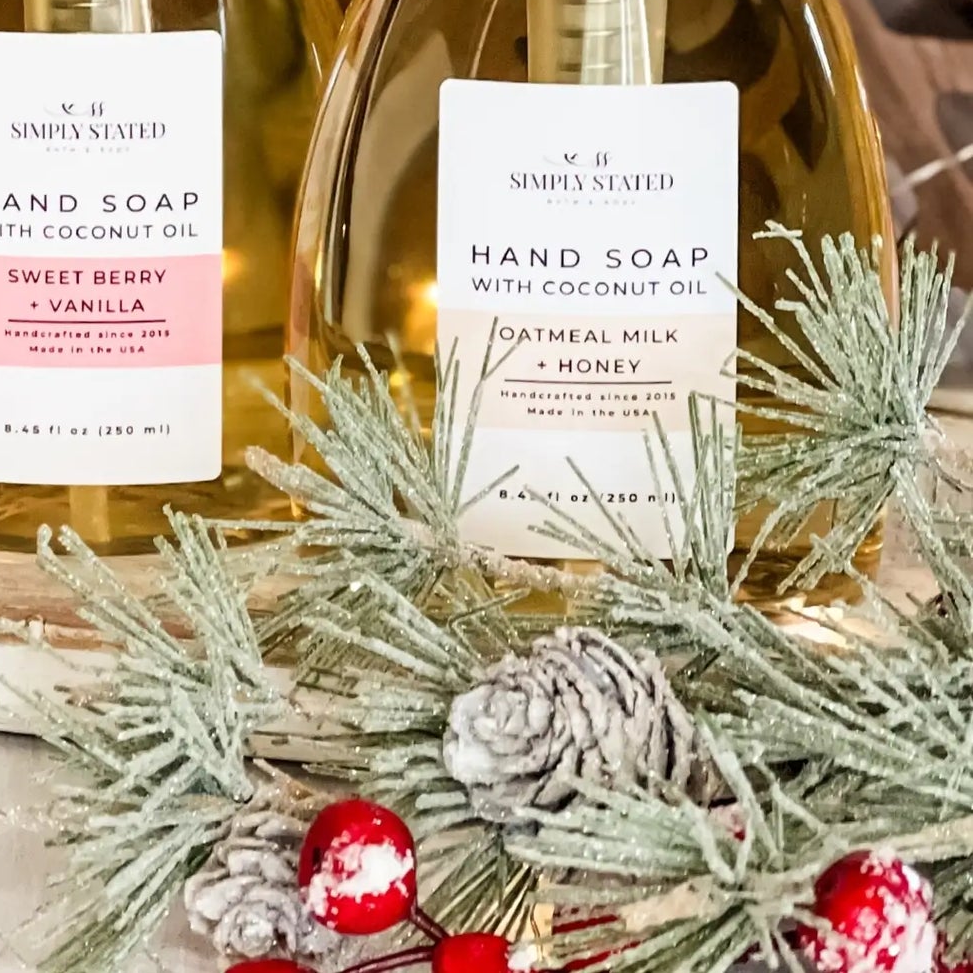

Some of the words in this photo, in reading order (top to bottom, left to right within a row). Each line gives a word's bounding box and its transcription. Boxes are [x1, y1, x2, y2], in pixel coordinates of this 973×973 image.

[11, 122, 82, 140] SIMPLY
[89, 122, 165, 140] STATED
[510, 172, 585, 191] SIMPLY
[592, 173, 673, 191] STATED
[102, 192, 198, 212] SOAP
[43, 224, 153, 239] COCONUT
[163, 223, 198, 238] OIL
[472, 245, 580, 268] HAND
[606, 247, 708, 268] SOAP
[8, 269, 83, 285] SWEET
[94, 269, 166, 285] BERRY
[472, 278, 531, 294] WITH
[543, 281, 660, 296] COCONUT
[670, 280, 707, 295] OIL
[50, 299, 145, 313] VANILLA
[5, 329, 90, 339] Handcrafted
[99, 330, 133, 339] since
[499, 327, 611, 344] OATMEAL
[623, 329, 678, 344] MILK
[559, 359, 641, 374] HONEY
[501, 390, 591, 401] Handcrafted
[601, 393, 638, 401] since
[646, 393, 676, 401] 2015
[528, 407, 563, 416] Made
[572, 408, 584, 416] in
[592, 409, 615, 417] the
[623, 409, 650, 417] USA
[5, 424, 39, 434] 8.45
[49, 425, 60, 434] fl
[71, 426, 87, 435] oz
[98, 426, 134, 436] (250
[144, 424, 170, 435] ml)
[499, 490, 541, 501] 8.4
[571, 494, 588, 502] oz
